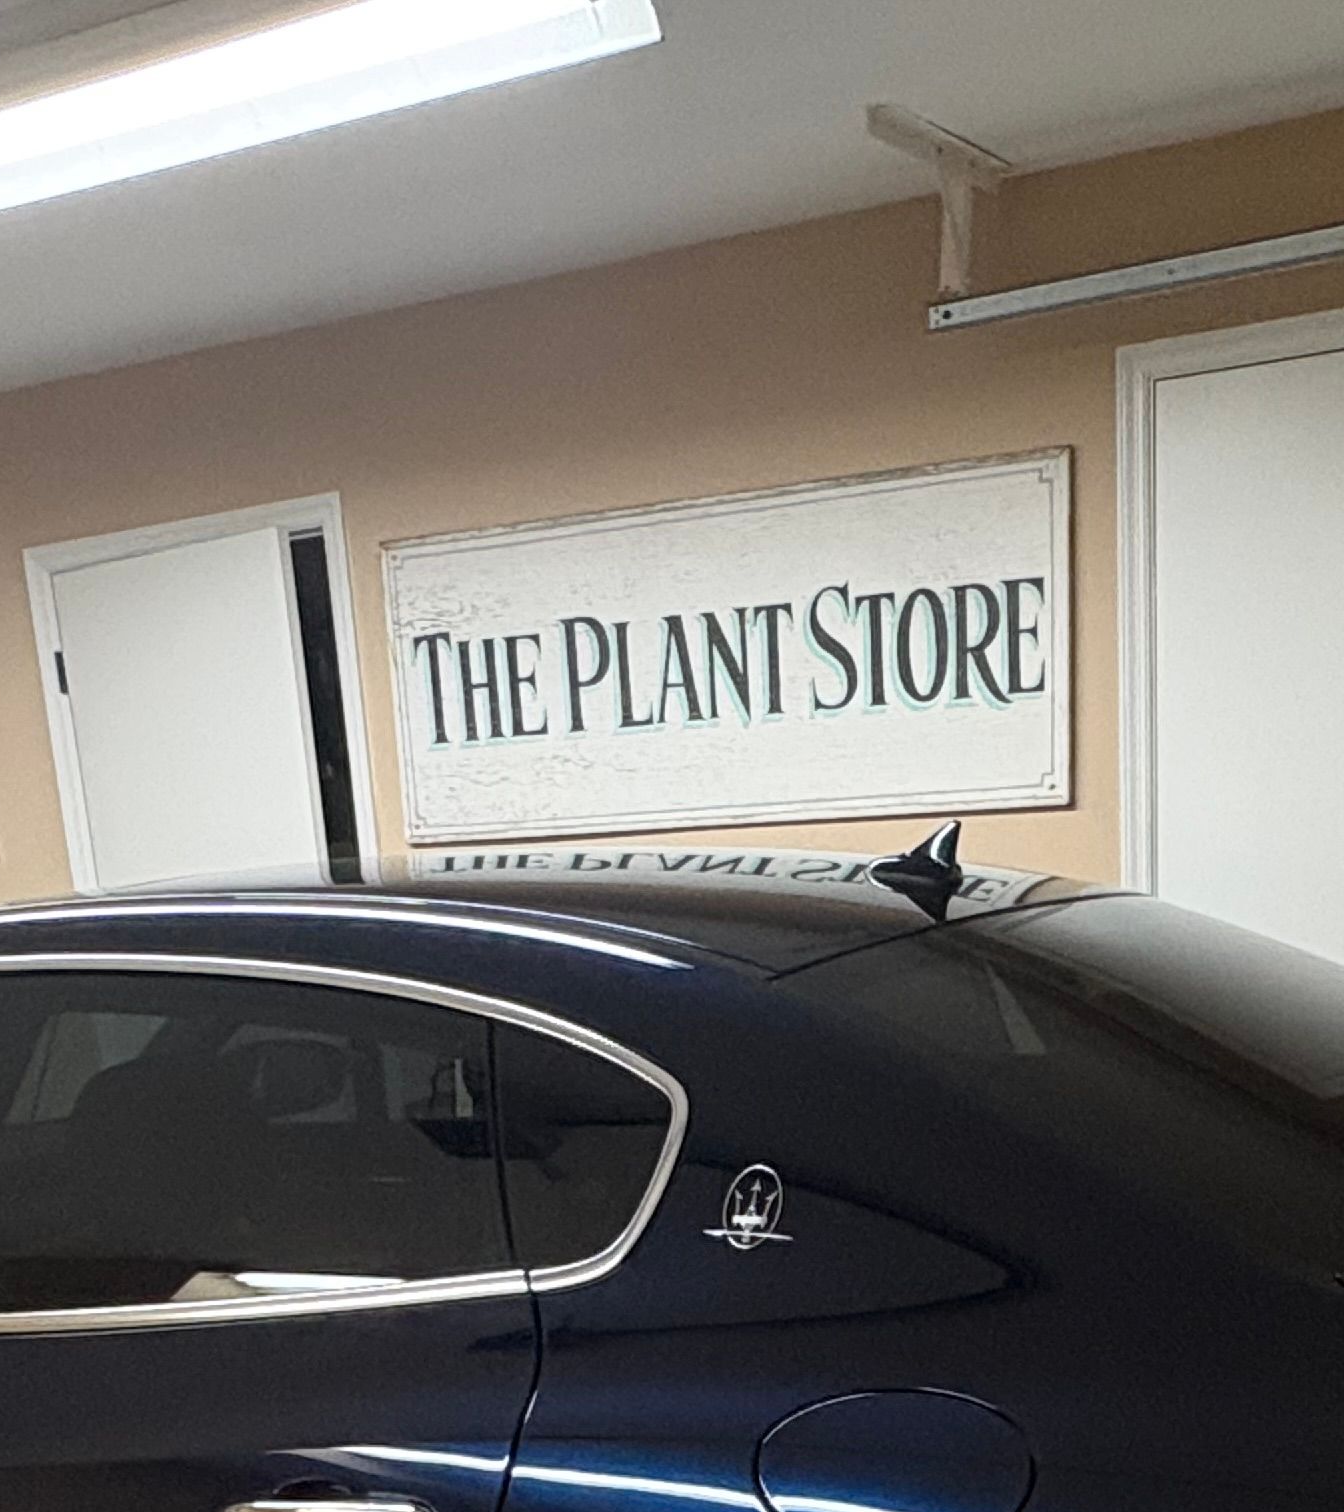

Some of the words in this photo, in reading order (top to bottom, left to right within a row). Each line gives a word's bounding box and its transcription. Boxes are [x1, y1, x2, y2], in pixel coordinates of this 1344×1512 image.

[413, 632, 549, 744] THE
[559, 602, 794, 734] PLANT
[806, 575, 1047, 712] STORE
